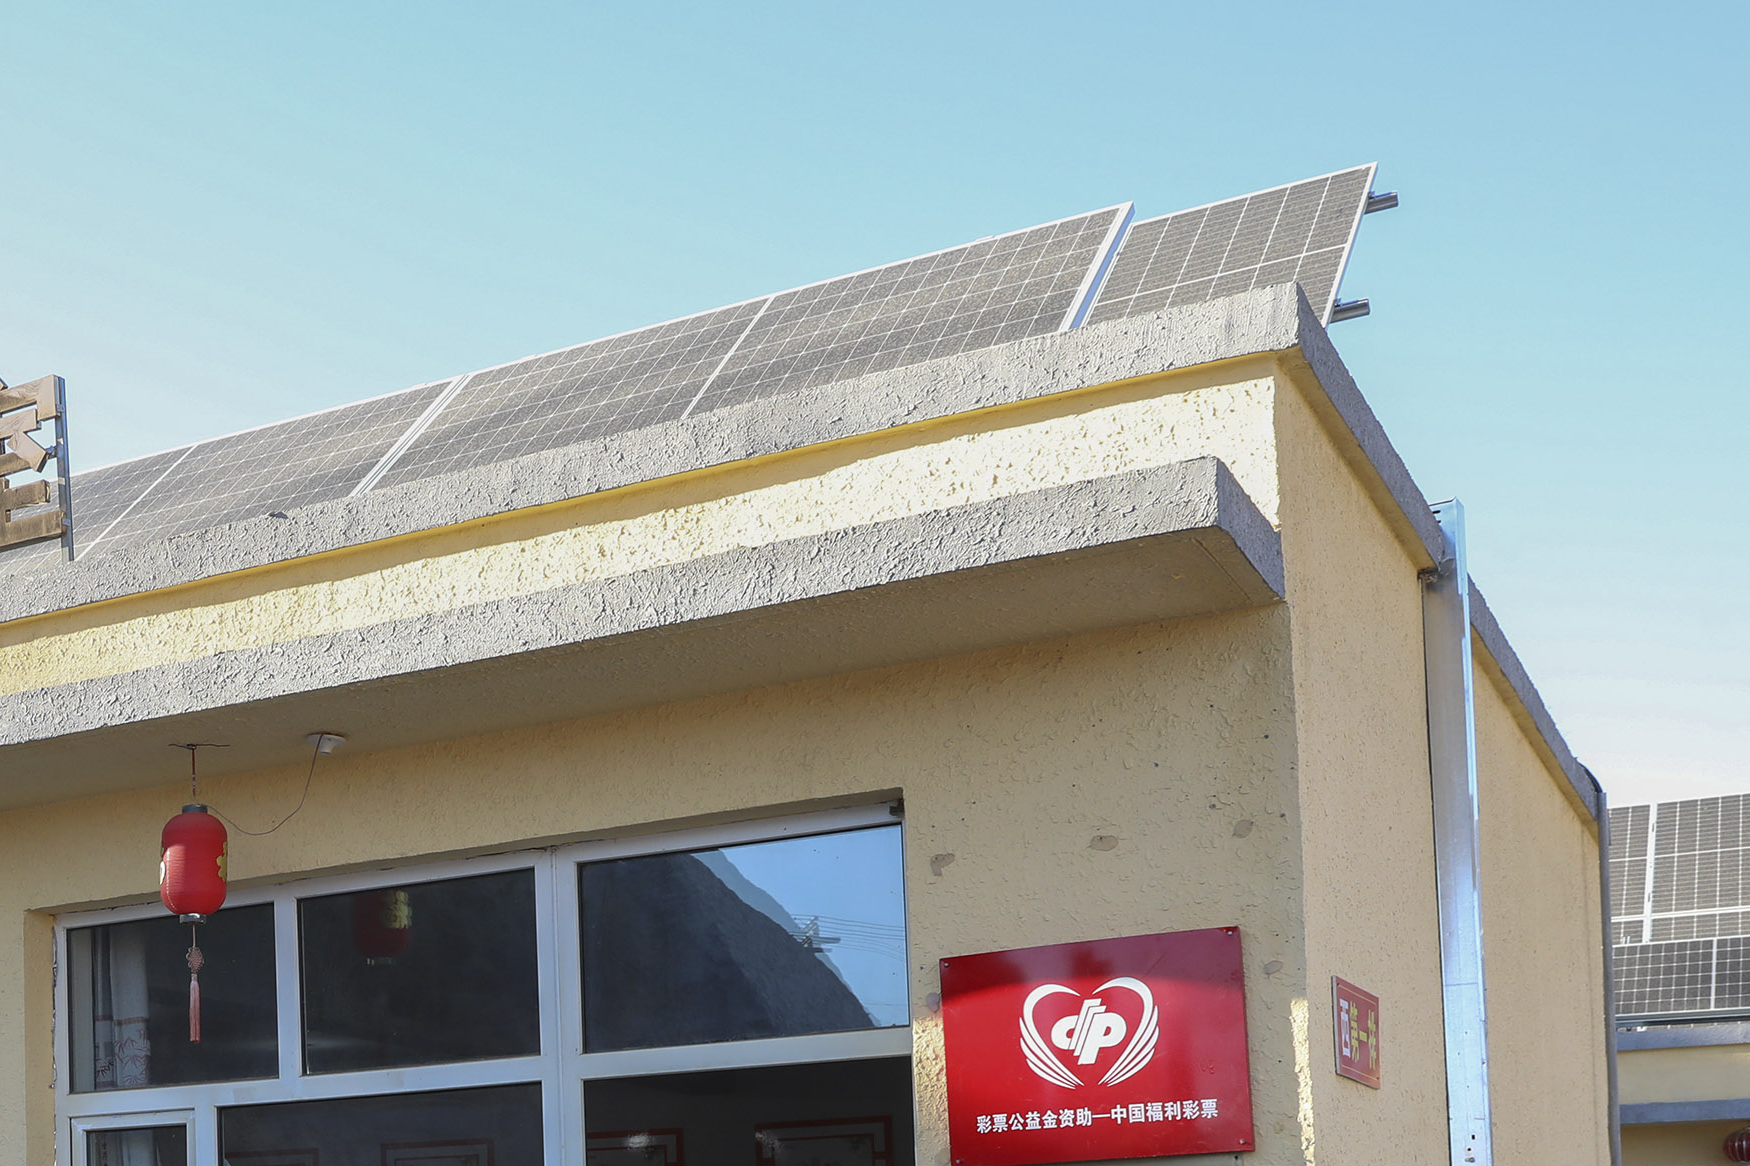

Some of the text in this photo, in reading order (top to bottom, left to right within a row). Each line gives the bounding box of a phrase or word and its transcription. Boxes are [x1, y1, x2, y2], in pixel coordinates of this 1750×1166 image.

[976, 1098, 1219, 1134] 彩票公益金资助—中国福利彩票
